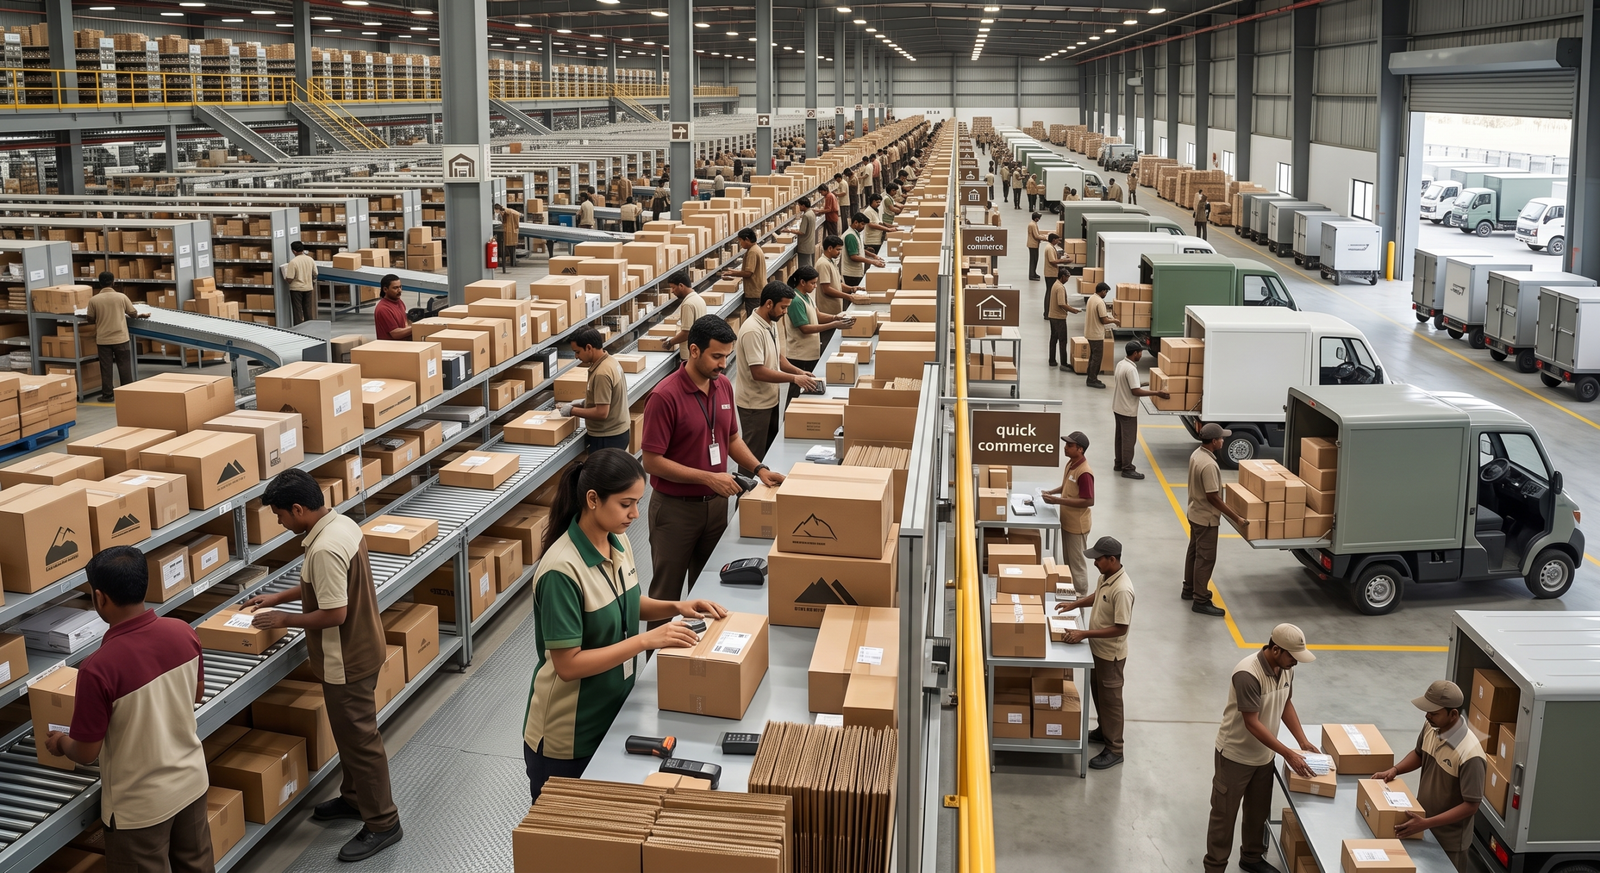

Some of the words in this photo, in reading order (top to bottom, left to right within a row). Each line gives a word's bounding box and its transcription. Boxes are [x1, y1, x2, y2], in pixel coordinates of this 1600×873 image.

[975, 234, 995, 243] quick
[996, 424, 1037, 439] quick
[978, 441, 1054, 455] commerce
